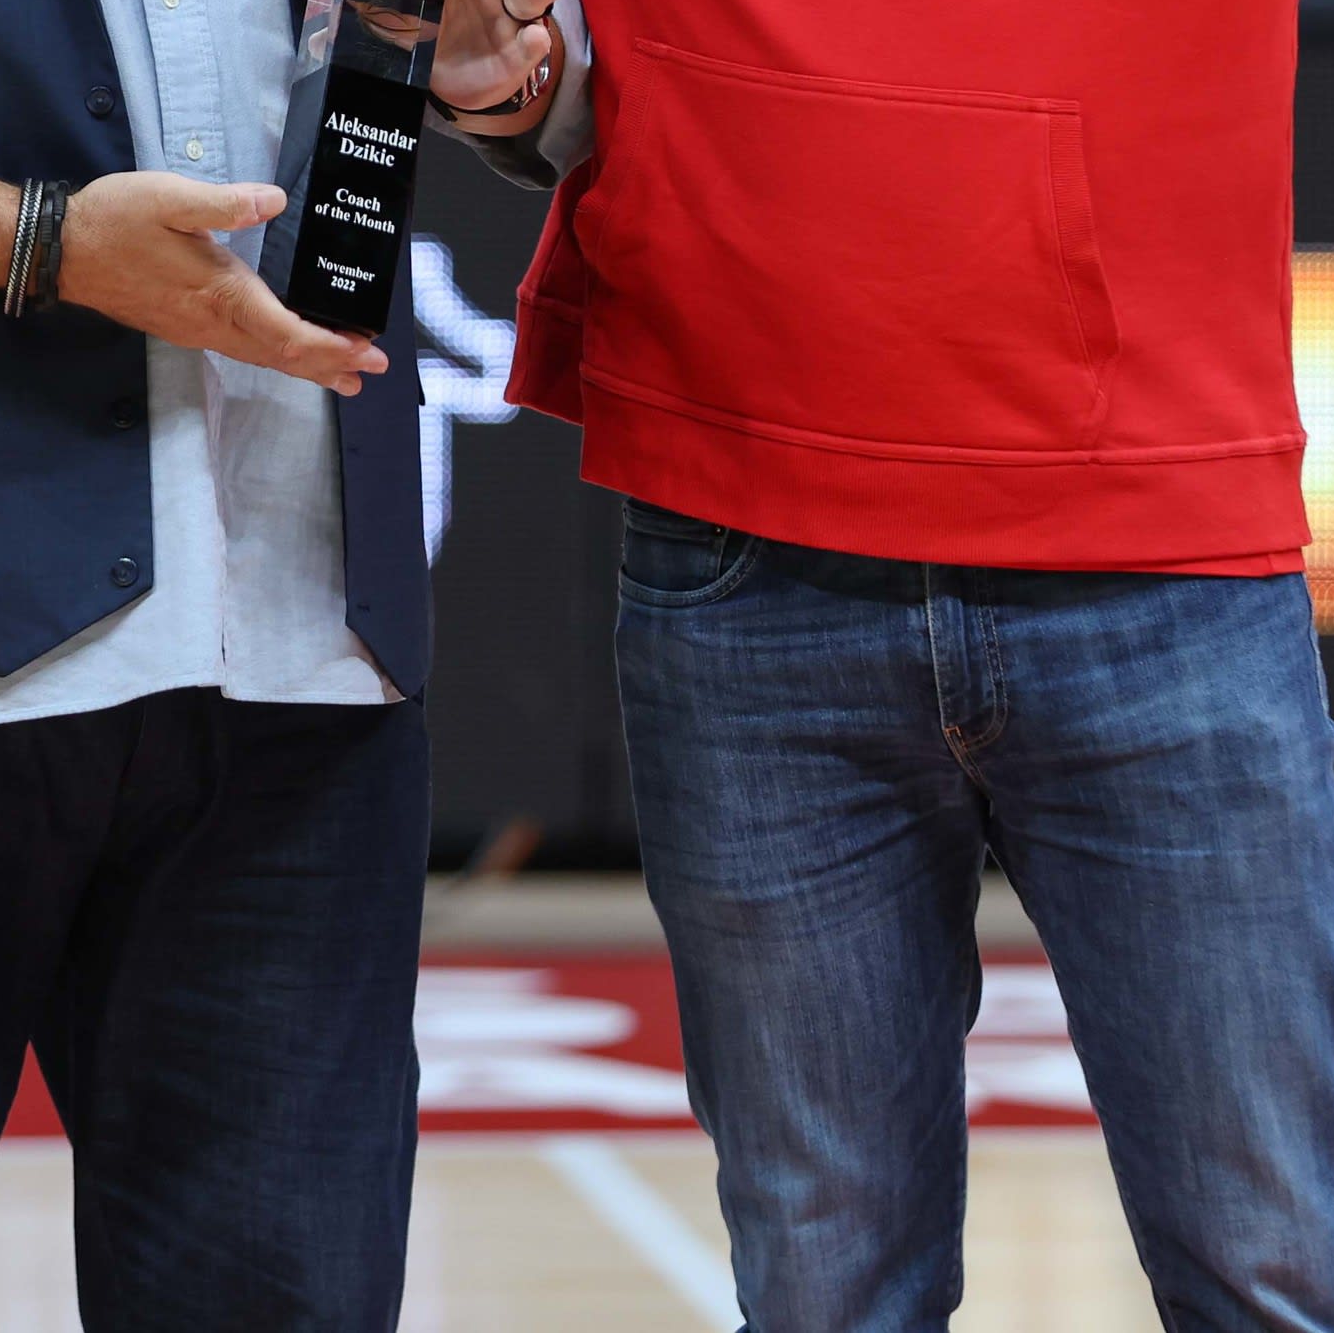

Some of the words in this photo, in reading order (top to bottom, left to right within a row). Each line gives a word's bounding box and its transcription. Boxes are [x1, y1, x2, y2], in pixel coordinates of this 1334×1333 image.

[325, 111, 417, 151] Aleksandar
[339, 137, 396, 167] Dzikic
[335, 187, 381, 213] Coach
[314, 203, 330, 216] of
[330, 206, 351, 222] the
[353, 211, 396, 234] Month
[316, 256, 376, 283] November
[330, 275, 357, 292] 2022
